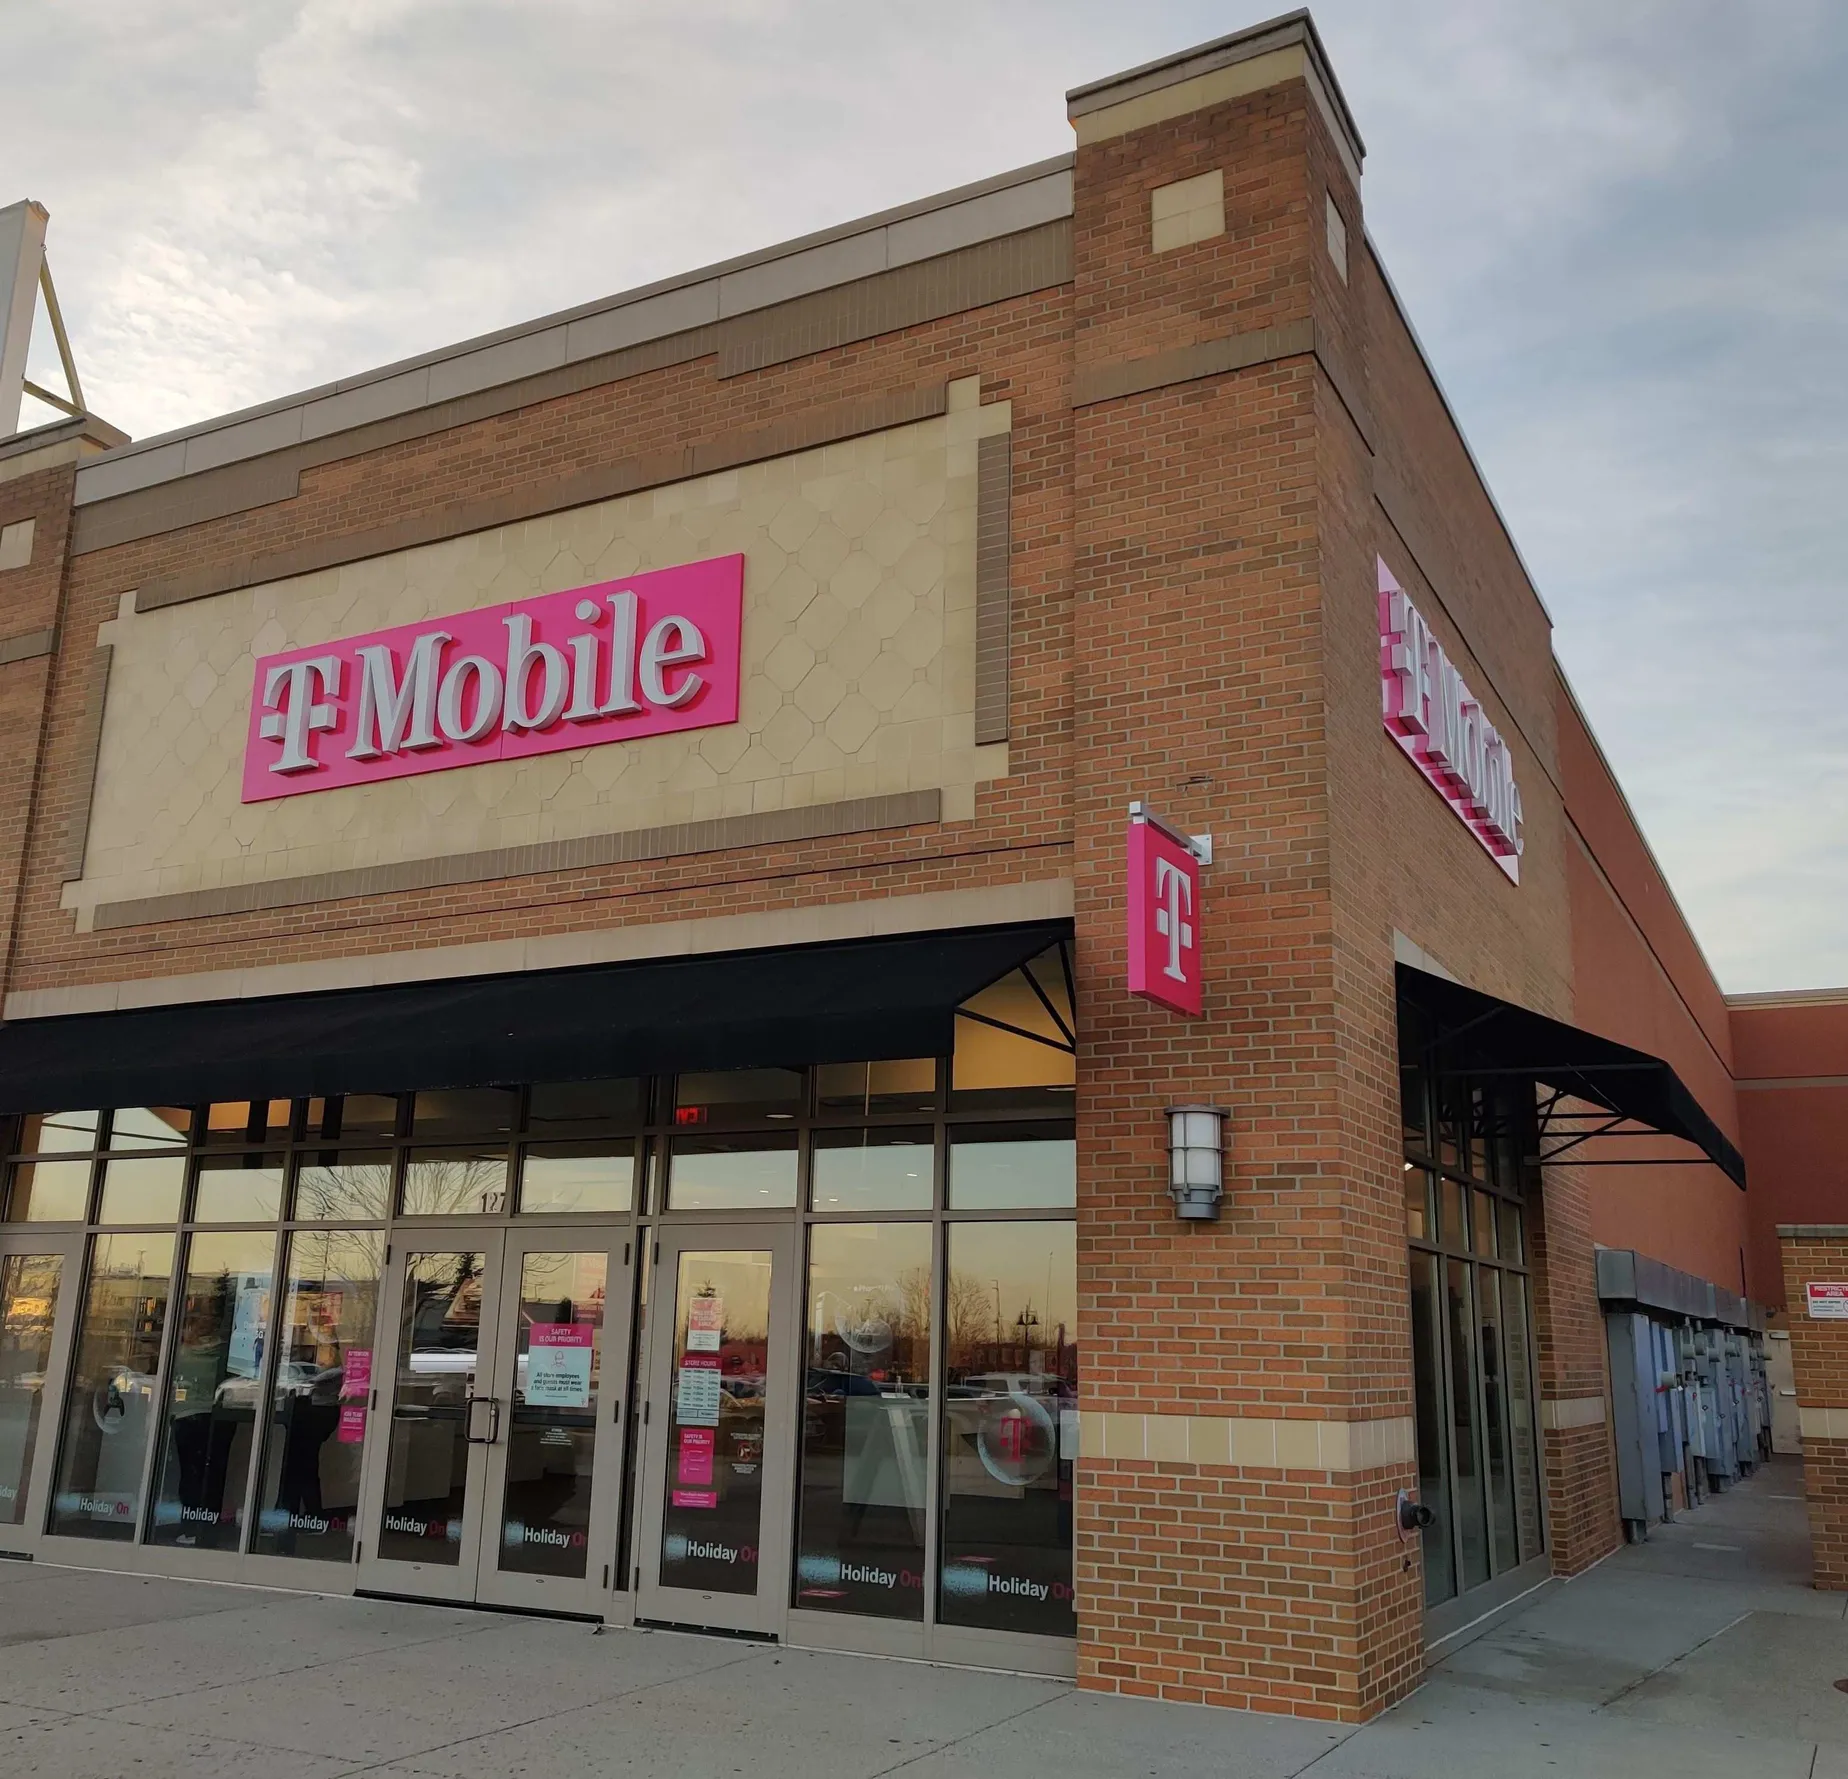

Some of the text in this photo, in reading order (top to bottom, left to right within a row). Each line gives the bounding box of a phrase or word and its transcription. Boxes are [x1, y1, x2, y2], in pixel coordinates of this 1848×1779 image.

[1156, 857, 1192, 984] T
[482, 1192, 506, 1212] 127
[555, 1372, 580, 1380] employees
[80, 1498, 129, 1517] Holiday On
[182, 1506, 219, 1525] Holiday
[289, 1514, 348, 1534] Holiday On
[385, 1515, 445, 1538] Holiday On
[525, 1527, 570, 1548] Holiday
[687, 1540, 738, 1564] Holiday
[841, 1564, 922, 1589] Holiday On
[989, 1575, 1049, 1600] Holiday
